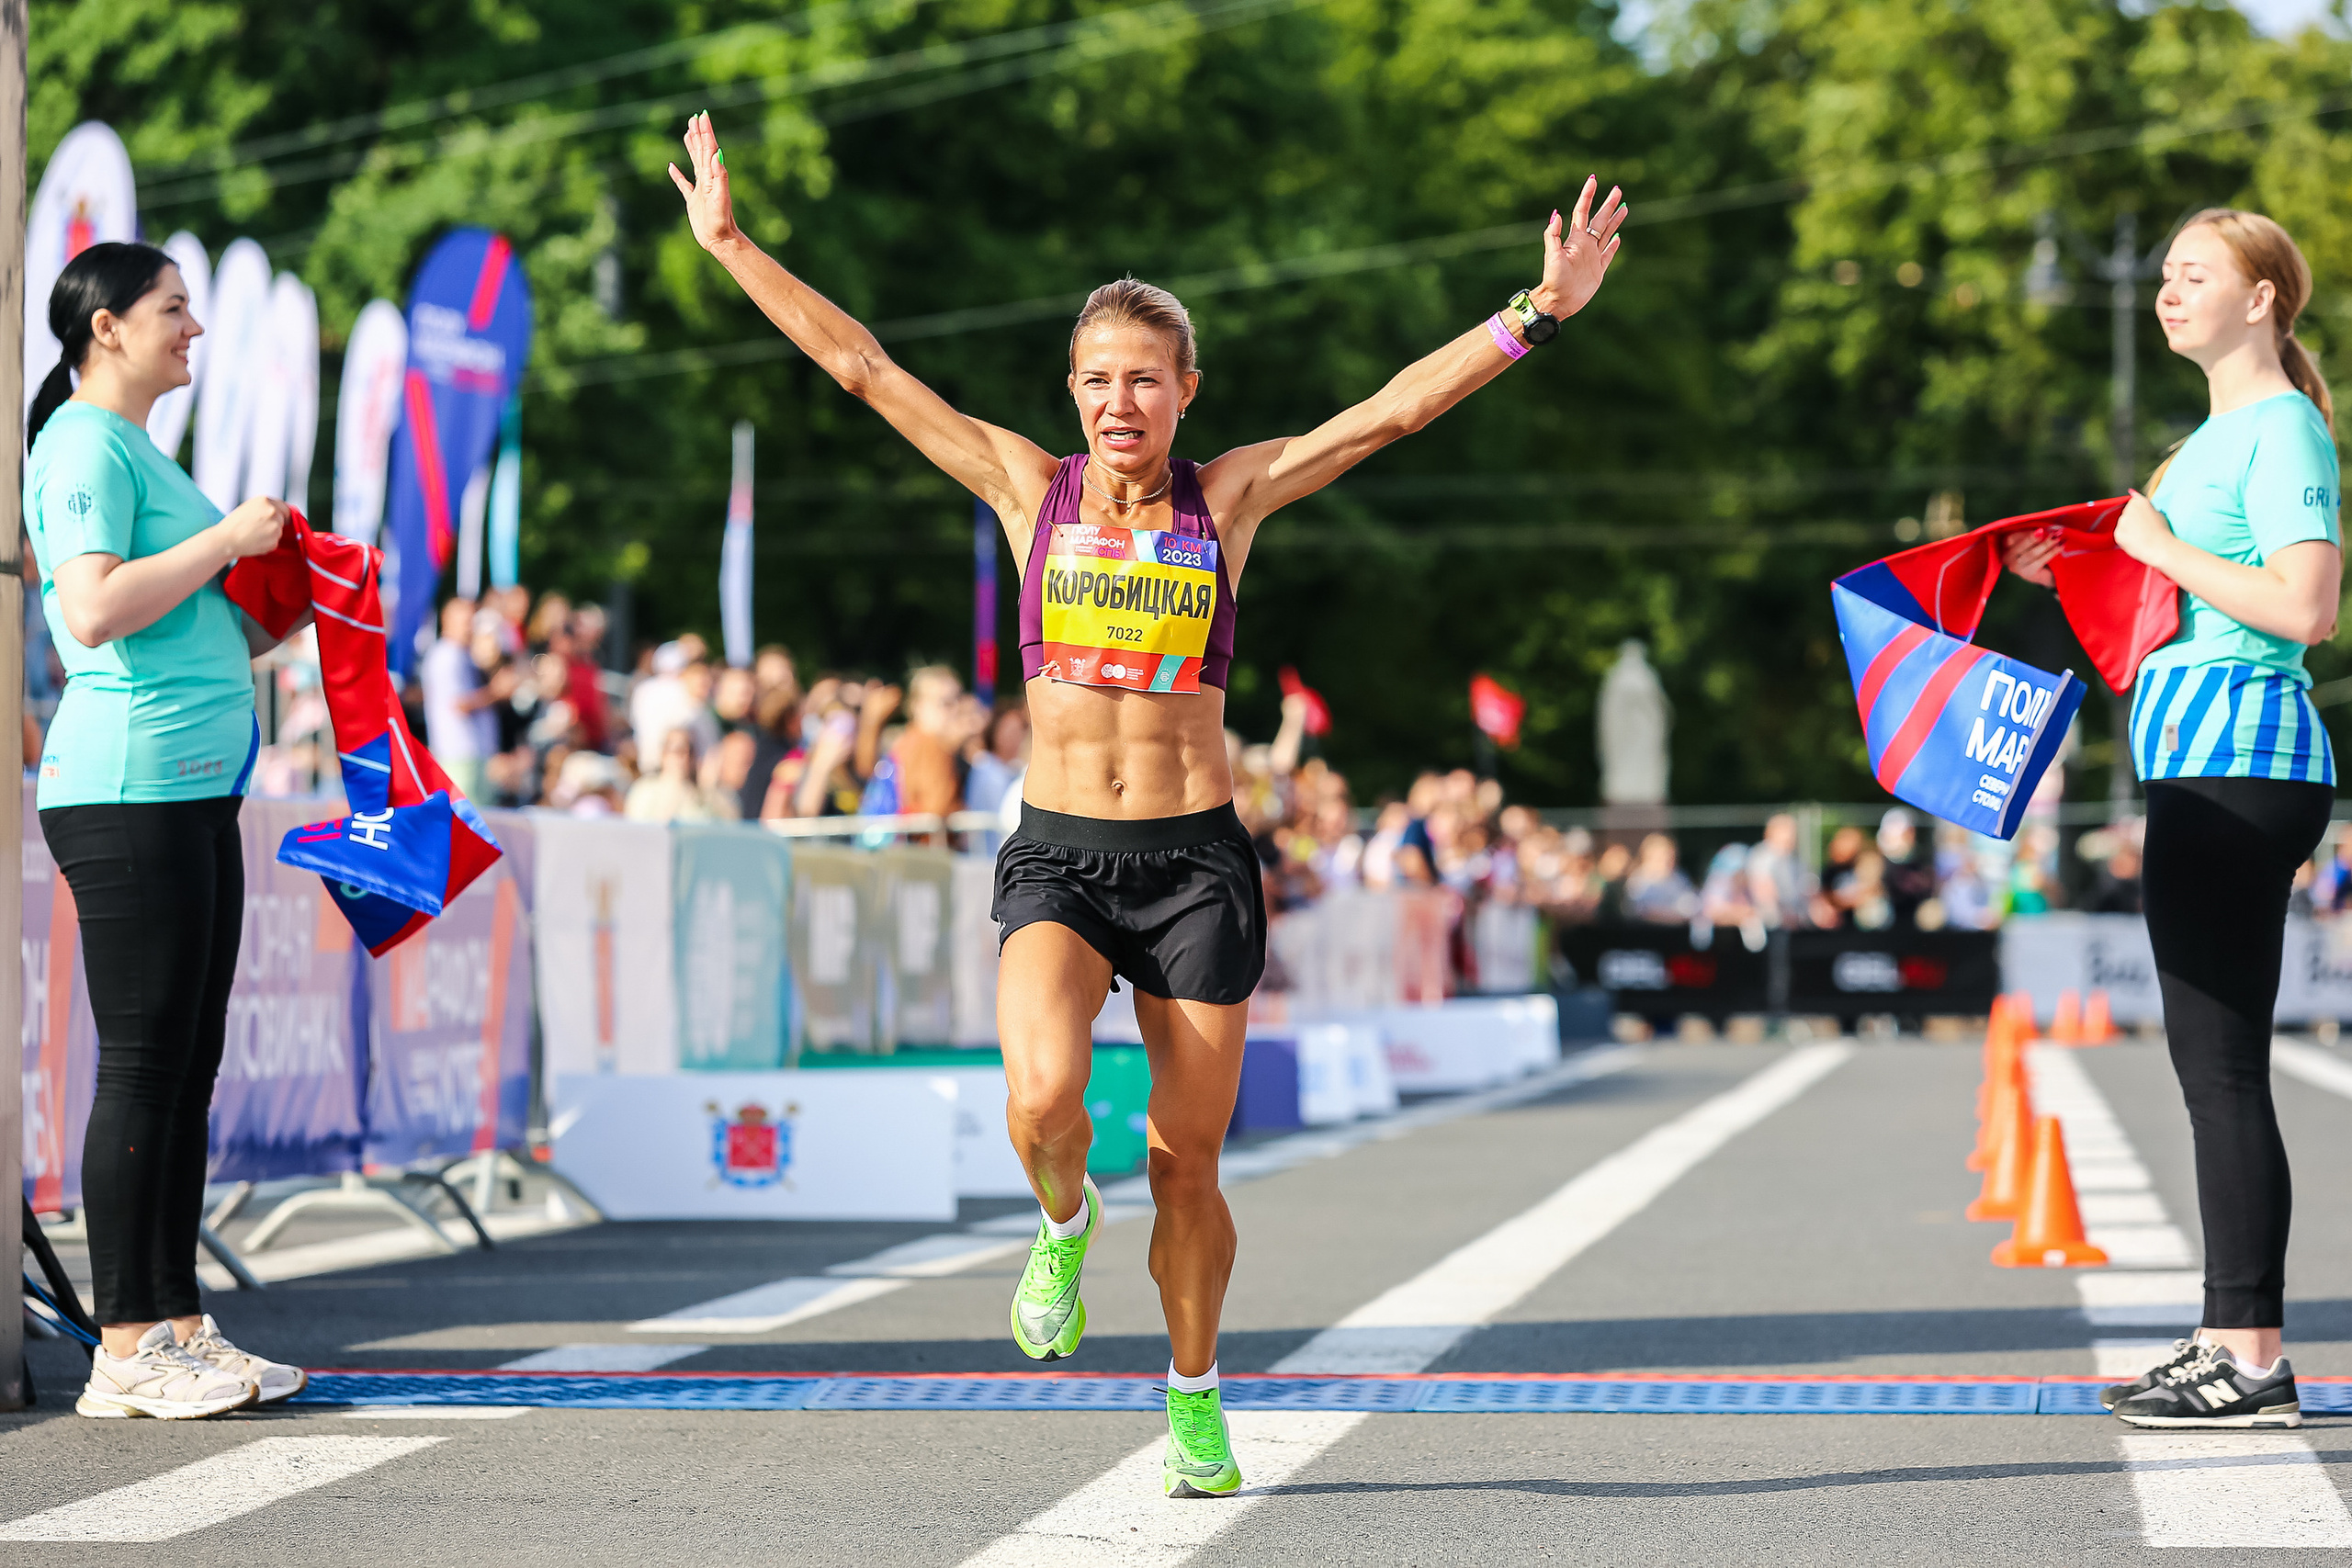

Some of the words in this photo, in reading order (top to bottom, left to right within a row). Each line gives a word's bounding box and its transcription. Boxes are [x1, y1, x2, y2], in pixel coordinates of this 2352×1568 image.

[1071, 525, 1102, 536] ПОЛУ
[1070, 535, 1125, 549] МАРАФОН
[1164, 536, 1177, 549] 10
[1182, 540, 1202, 553] КМ
[1162, 548, 1202, 567] 2023
[1047, 569, 1211, 620] КОРОБИЦКАЯ
[1106, 626, 1144, 642] 7022
